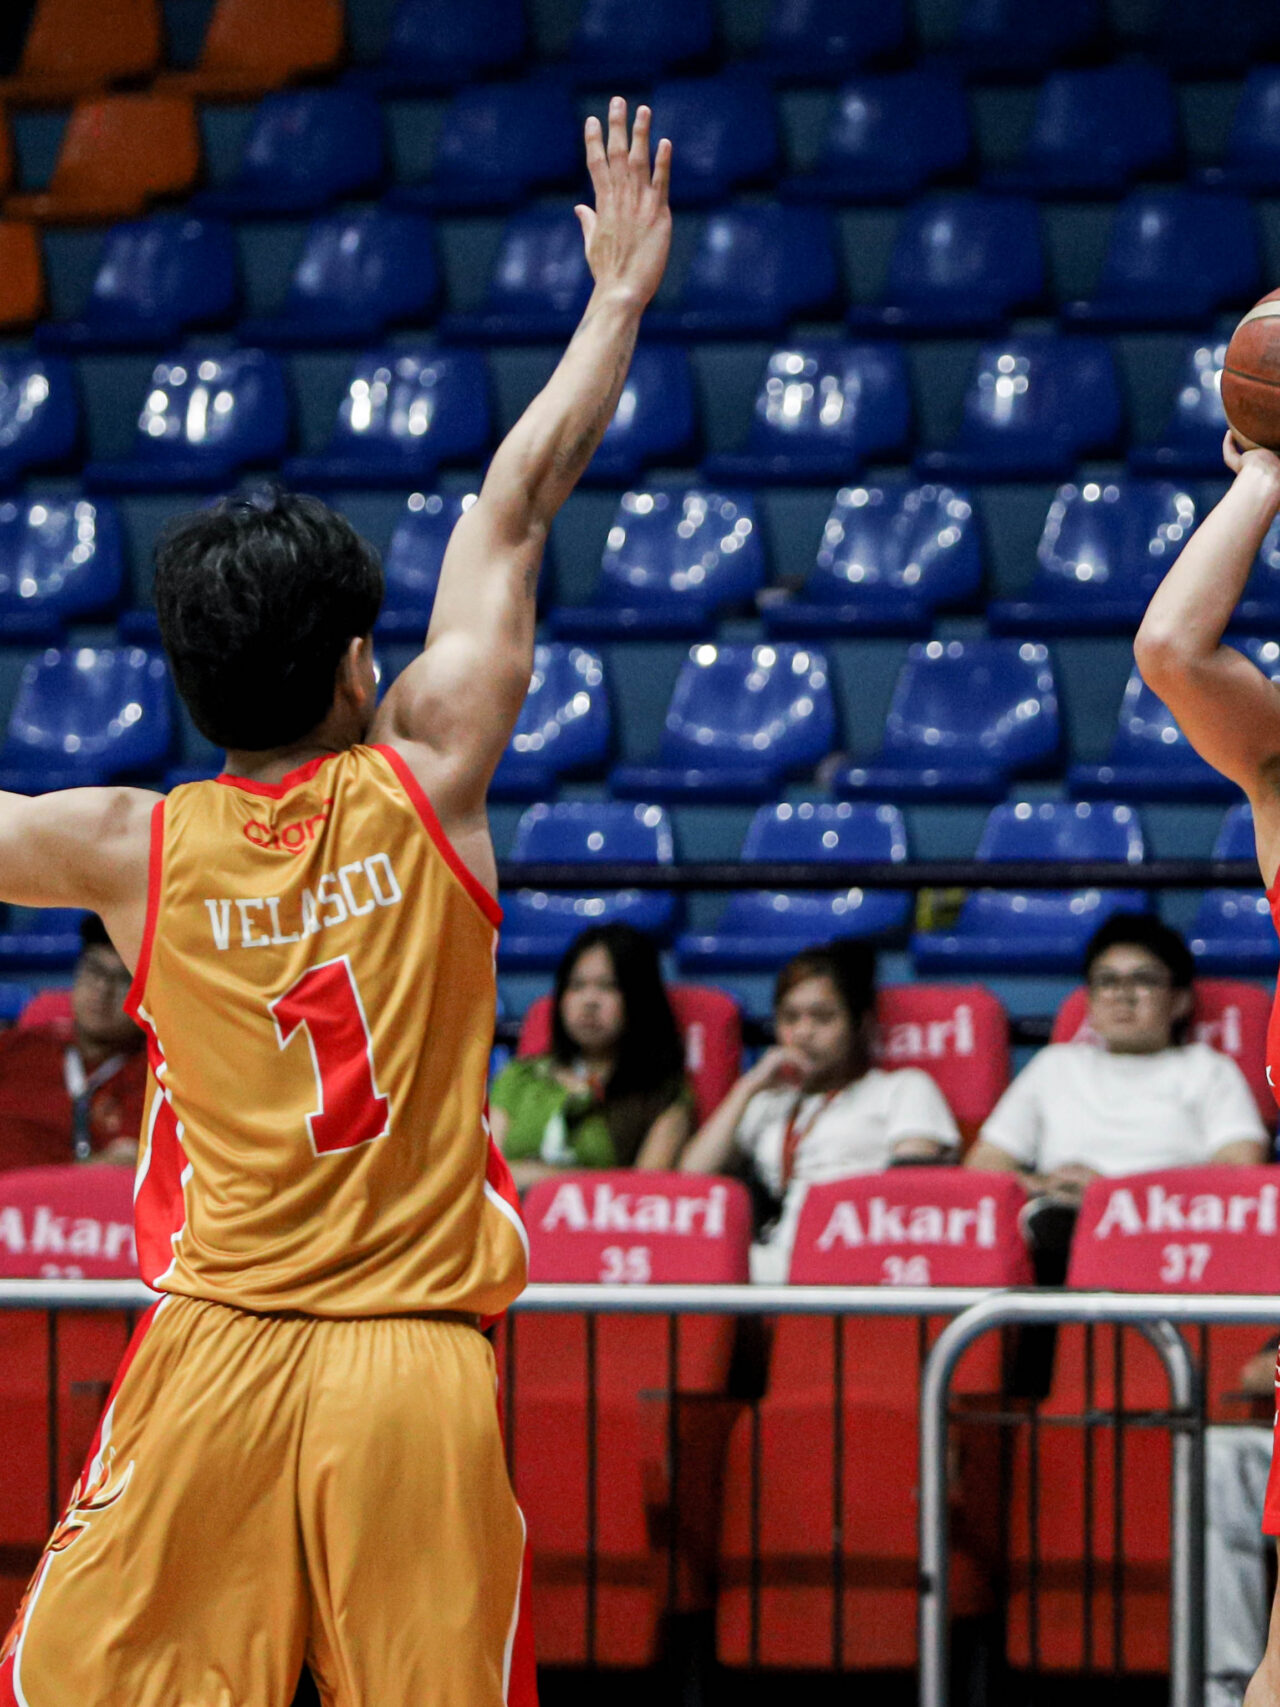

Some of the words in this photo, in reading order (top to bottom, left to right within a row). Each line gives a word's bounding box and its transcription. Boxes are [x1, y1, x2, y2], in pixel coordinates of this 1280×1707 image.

[204, 852, 403, 950] VELASCO
[267, 953, 392, 1159] 1
[870, 1004, 974, 1057] ari
[541, 1183, 727, 1238] Akari
[816, 1196, 997, 1250] Akari
[1095, 1183, 1279, 1238] Akari
[600, 1245, 651, 1283] 35
[1160, 1243, 1212, 1283] 37
